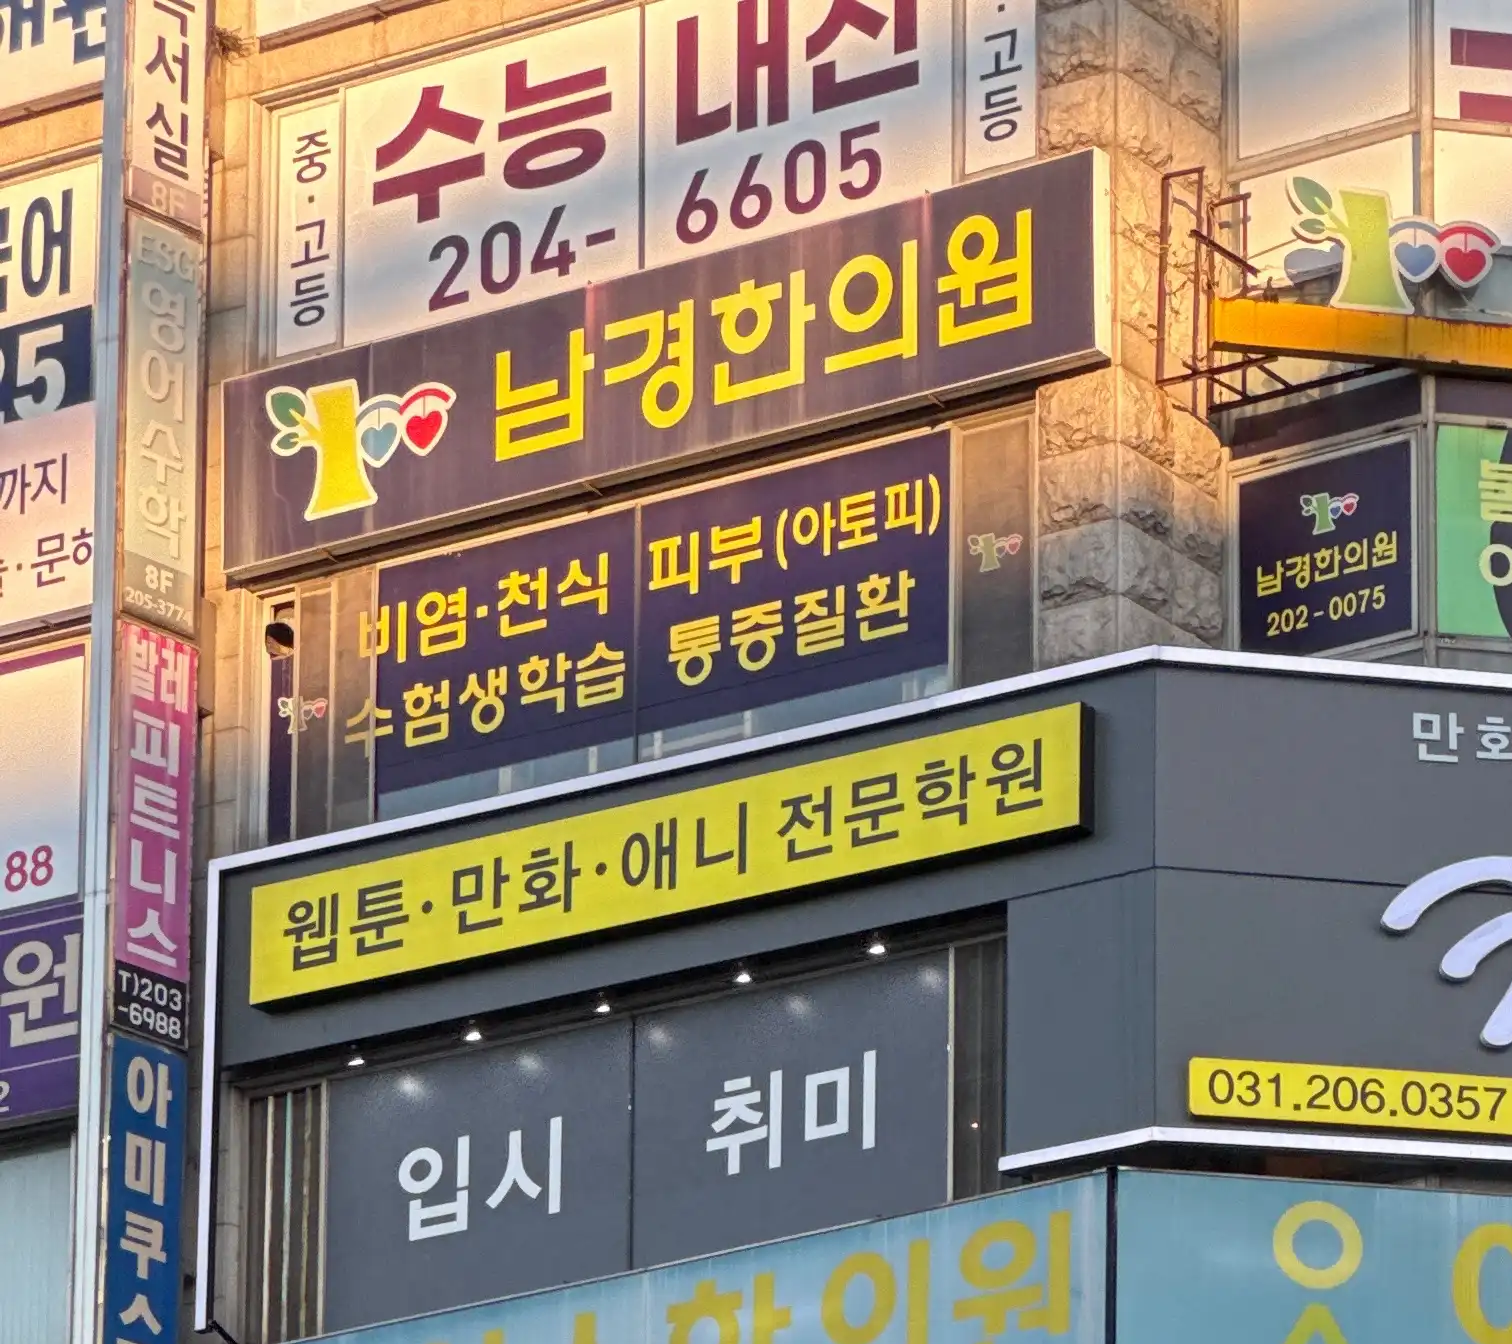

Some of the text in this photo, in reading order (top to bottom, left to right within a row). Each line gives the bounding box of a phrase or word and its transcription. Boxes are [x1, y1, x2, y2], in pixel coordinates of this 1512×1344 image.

[371, 0, 921, 225] 수능 내신
[150, 180, 187, 218] 8F
[493, 208, 1034, 464] 남경한의원
[145, 564, 175, 595] 8F
[357, 551, 611, 666] 비염·천식
[1255, 530, 1398, 598] 남경한의원
[130, 636, 190, 714] 발레
[343, 568, 918, 766] 수험생학습 통증질환
[776, 737, 1047, 861] 전문학원
[397, 1049, 878, 1242] 입시 취미
[1207, 1067, 1508, 1124] 031.206.0357
